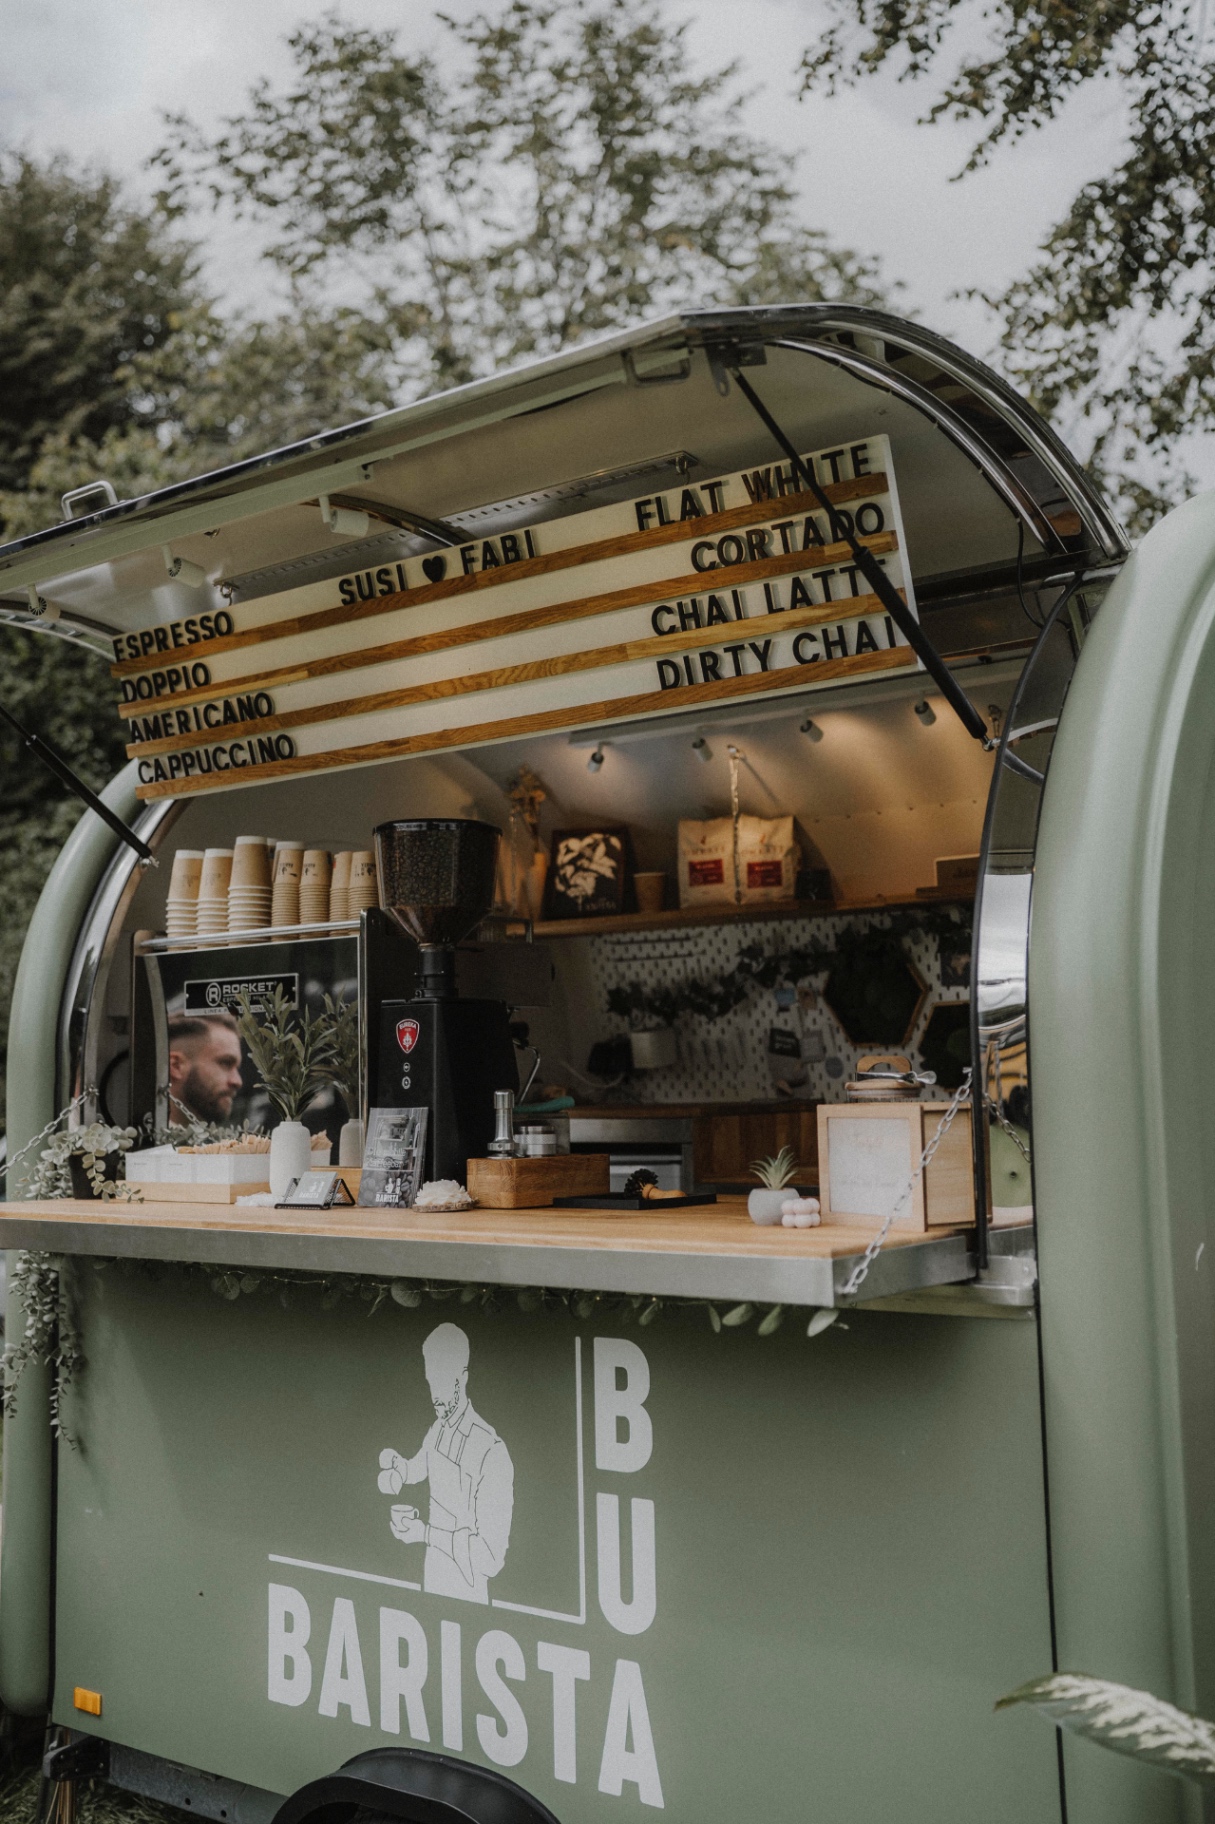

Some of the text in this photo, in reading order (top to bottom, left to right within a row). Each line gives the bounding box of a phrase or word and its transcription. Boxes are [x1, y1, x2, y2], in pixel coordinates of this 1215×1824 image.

[635, 443, 872, 531] FLAT WHITE
[338, 529, 537, 606] SUSI FABI
[690, 502, 885, 574] CORTADO
[651, 558, 886, 637] CHAI LATT
[112, 611, 234, 663] ESPRESSO
[656, 615, 897, 691] DIRTY CHAI
[121, 662, 211, 704] DOPPIO
[130, 692, 275, 744] AMERICANO
[137, 733, 297, 785] CAPPUCCINO
[222, 981, 275, 995] ROCKET
[375, 1193, 399, 1203] BARISTA
[267, 1582, 666, 1810] BARISTA
